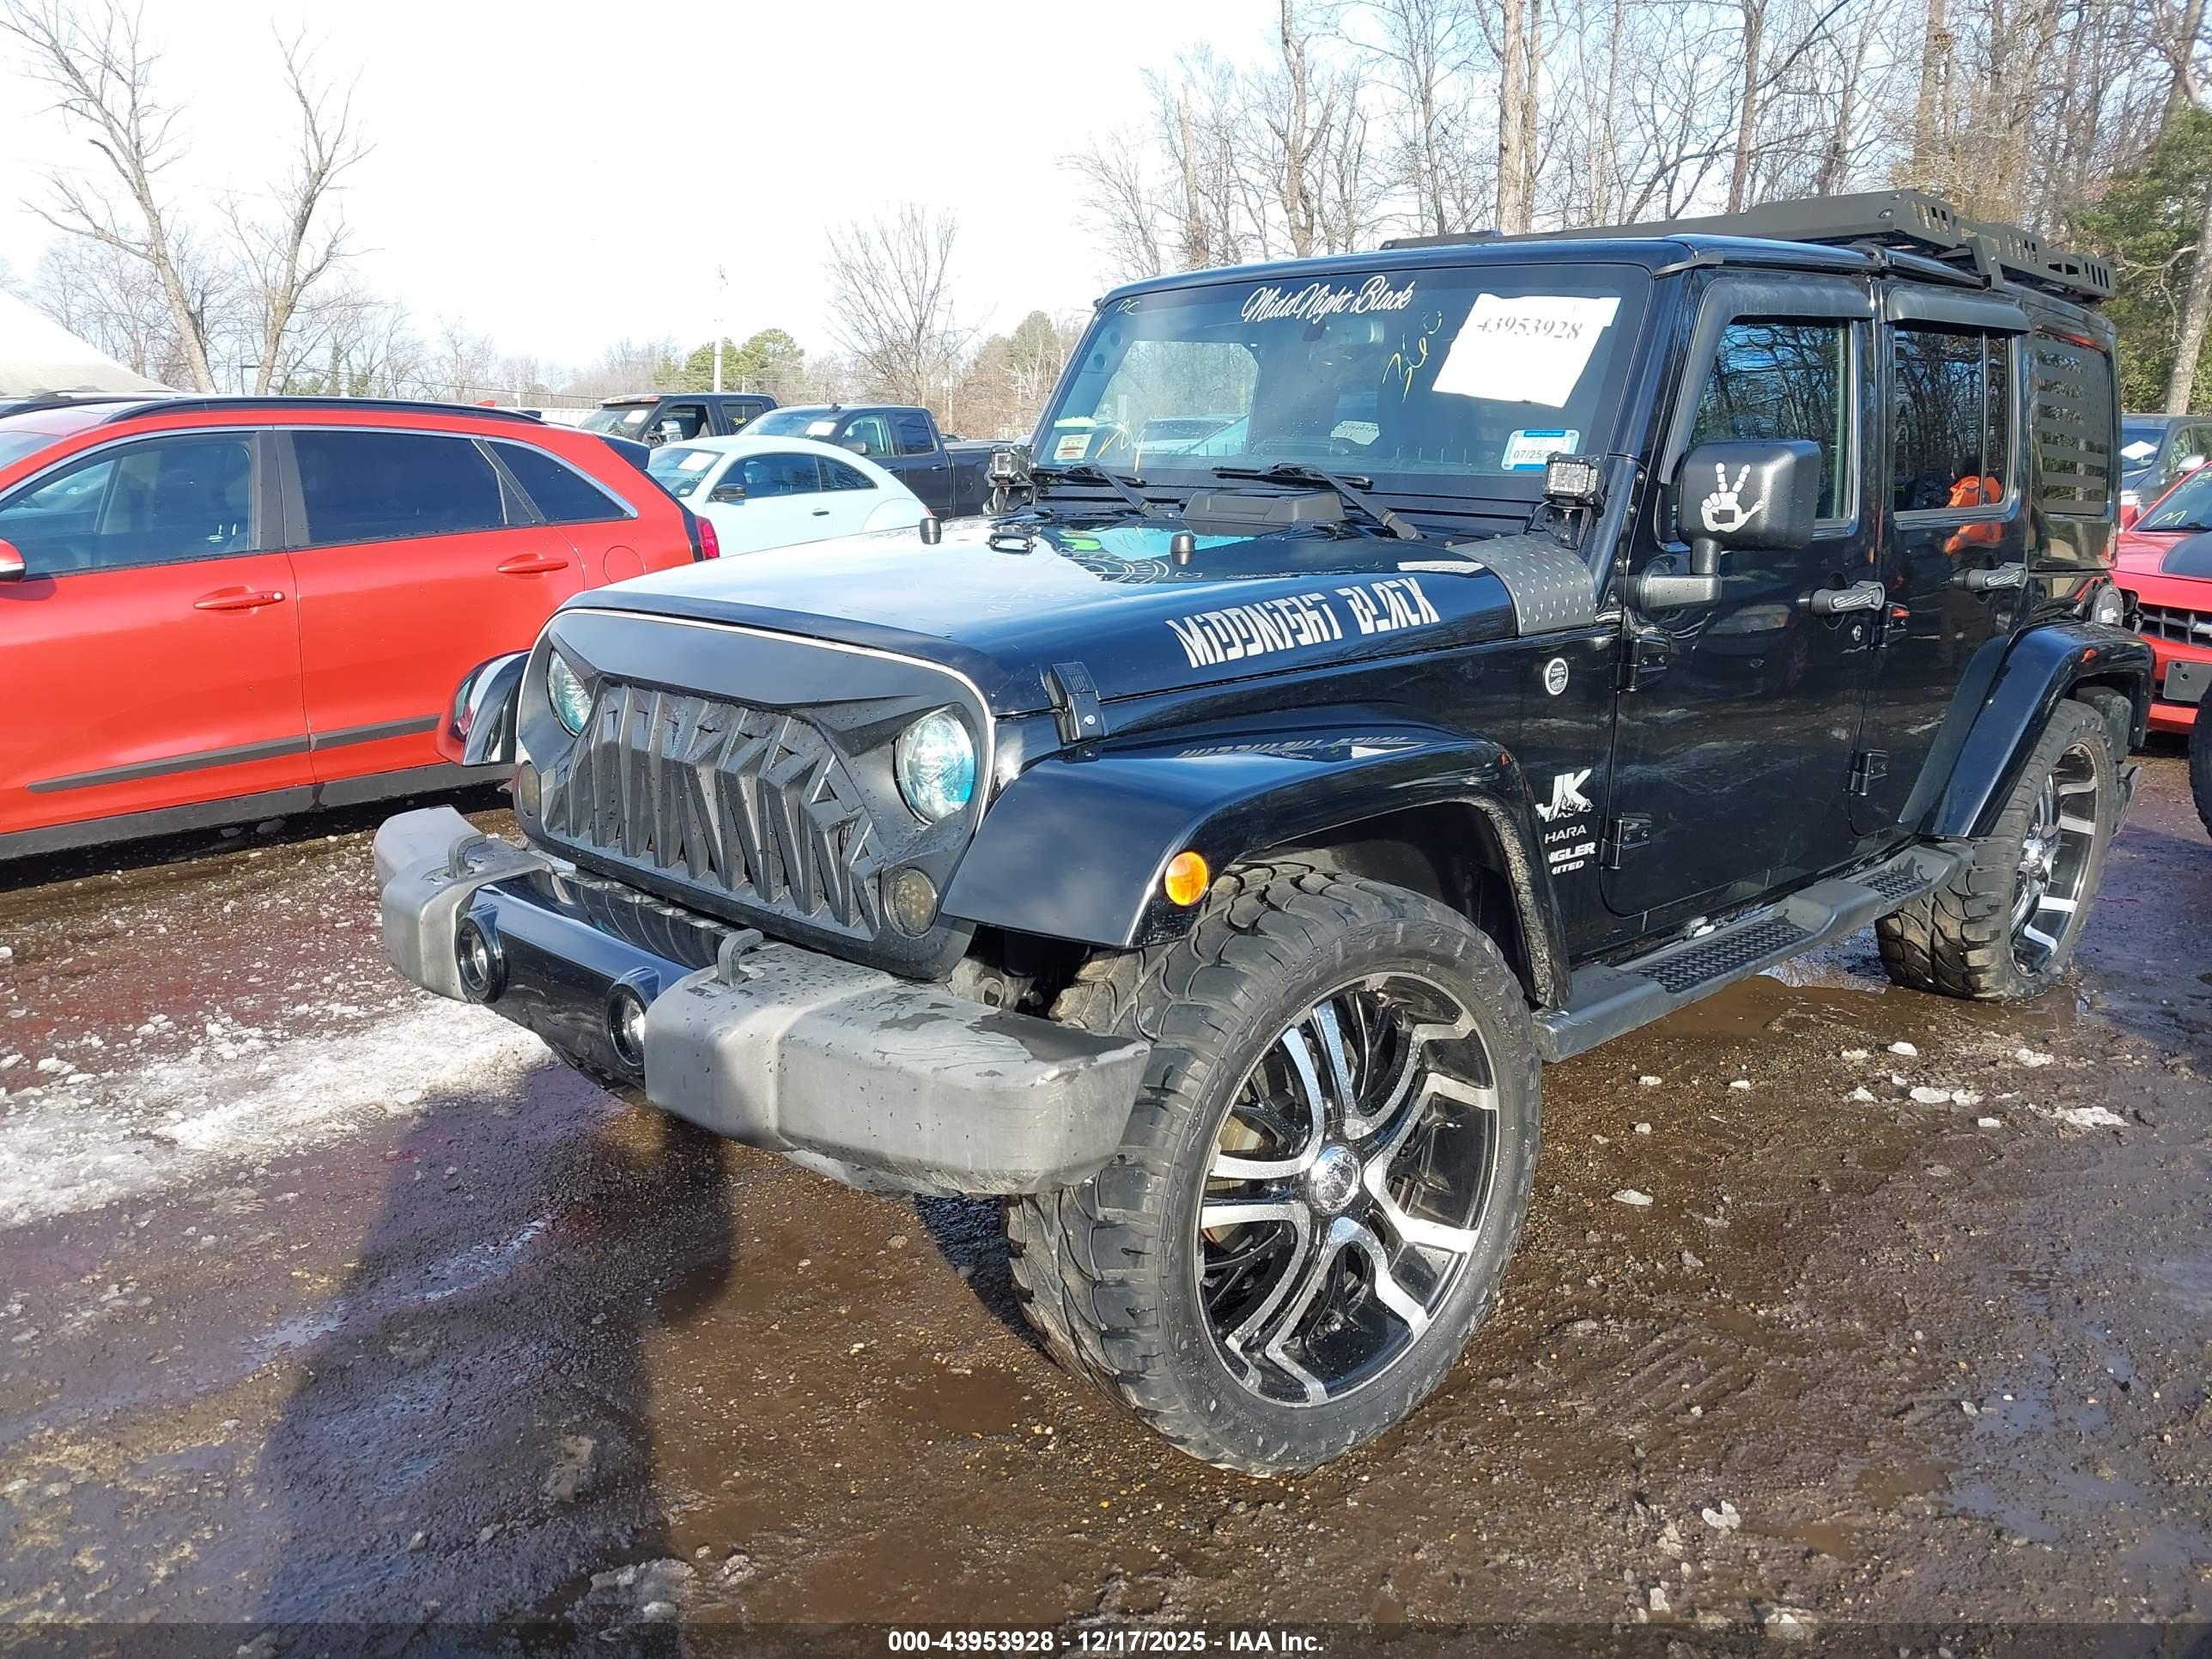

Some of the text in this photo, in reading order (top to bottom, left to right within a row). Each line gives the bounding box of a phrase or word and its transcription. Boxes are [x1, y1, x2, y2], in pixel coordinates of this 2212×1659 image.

[1350, 275, 1416, 313] Black
[1476, 316, 1583, 340] 43953928
[1334, 576, 1441, 635] BLACK
